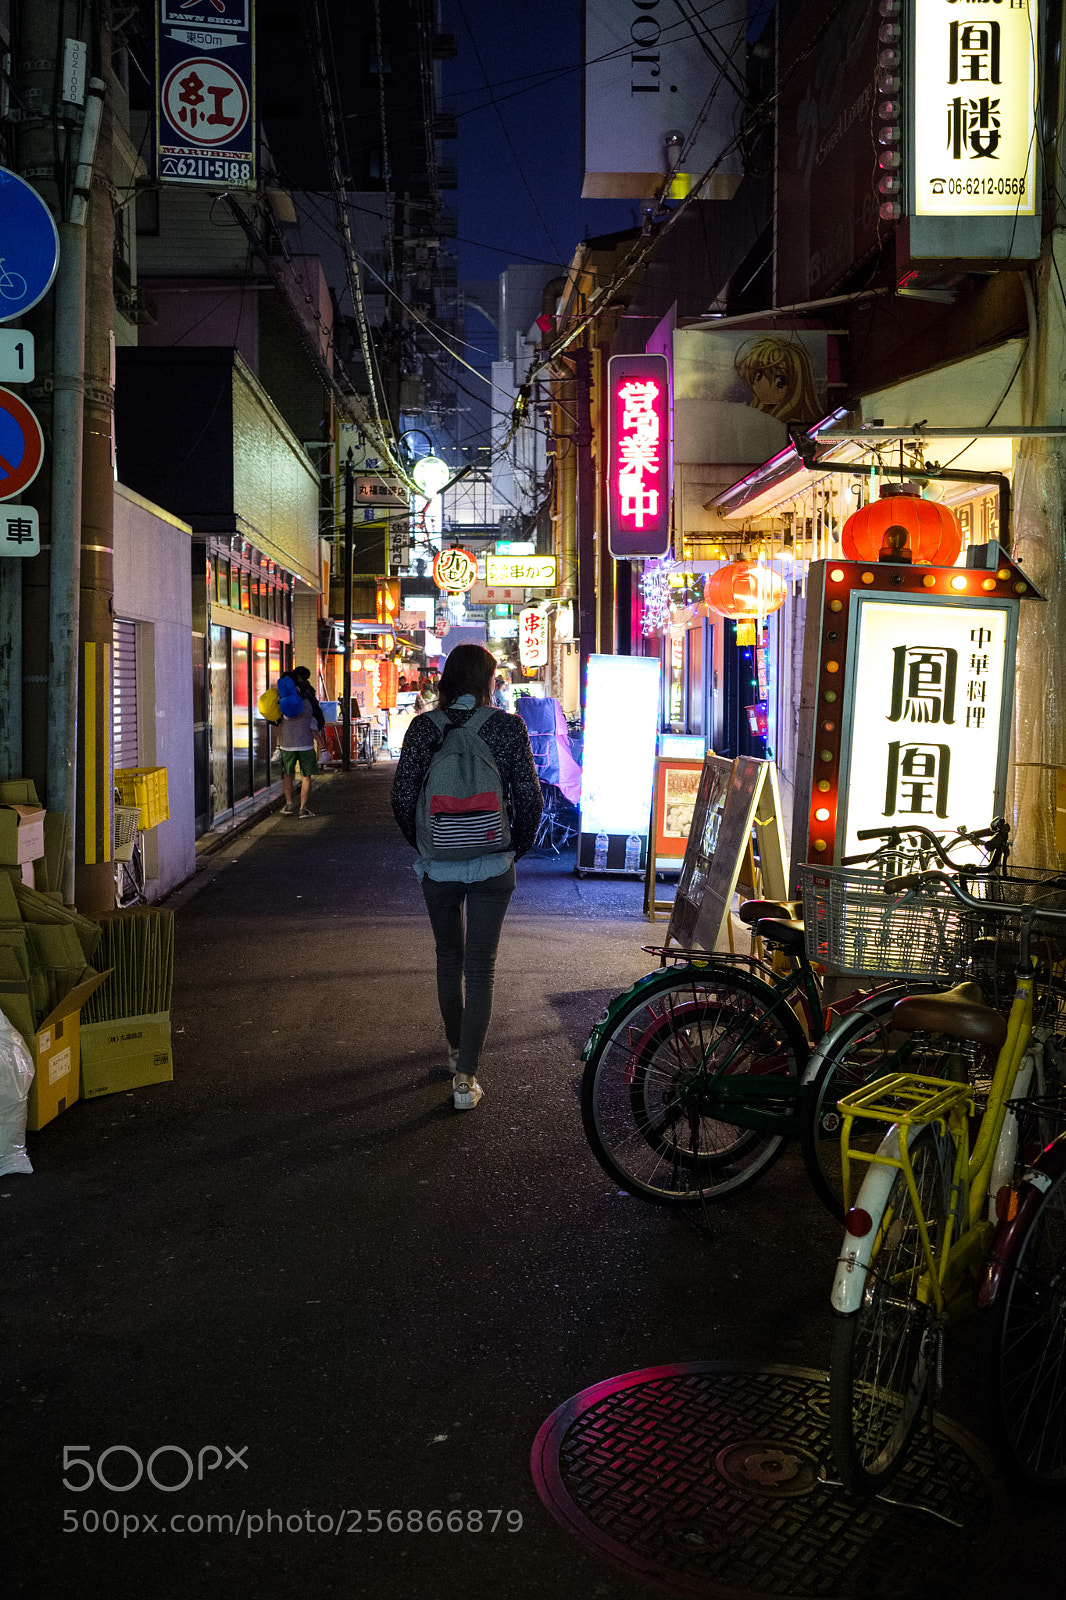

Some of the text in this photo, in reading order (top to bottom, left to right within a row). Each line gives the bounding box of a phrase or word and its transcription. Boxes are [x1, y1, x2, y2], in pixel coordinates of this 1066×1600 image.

[168, 12, 242, 25] PAWN SHOP
[186, 32, 222, 46] 東50m
[630, 0, 679, 98] ori
[946, 0, 1002, 160] 凰楼
[178, 71, 235, 129] 紅
[162, 147, 251, 160] MARUBENI
[948, 177, 1026, 196] 06-6212-0568
[6, 517, 34, 545] 車
[510, 564, 554, 579] 串かつ
[524, 612, 540, 659] 串かつ
[966, 627, 991, 729] 中華料理
